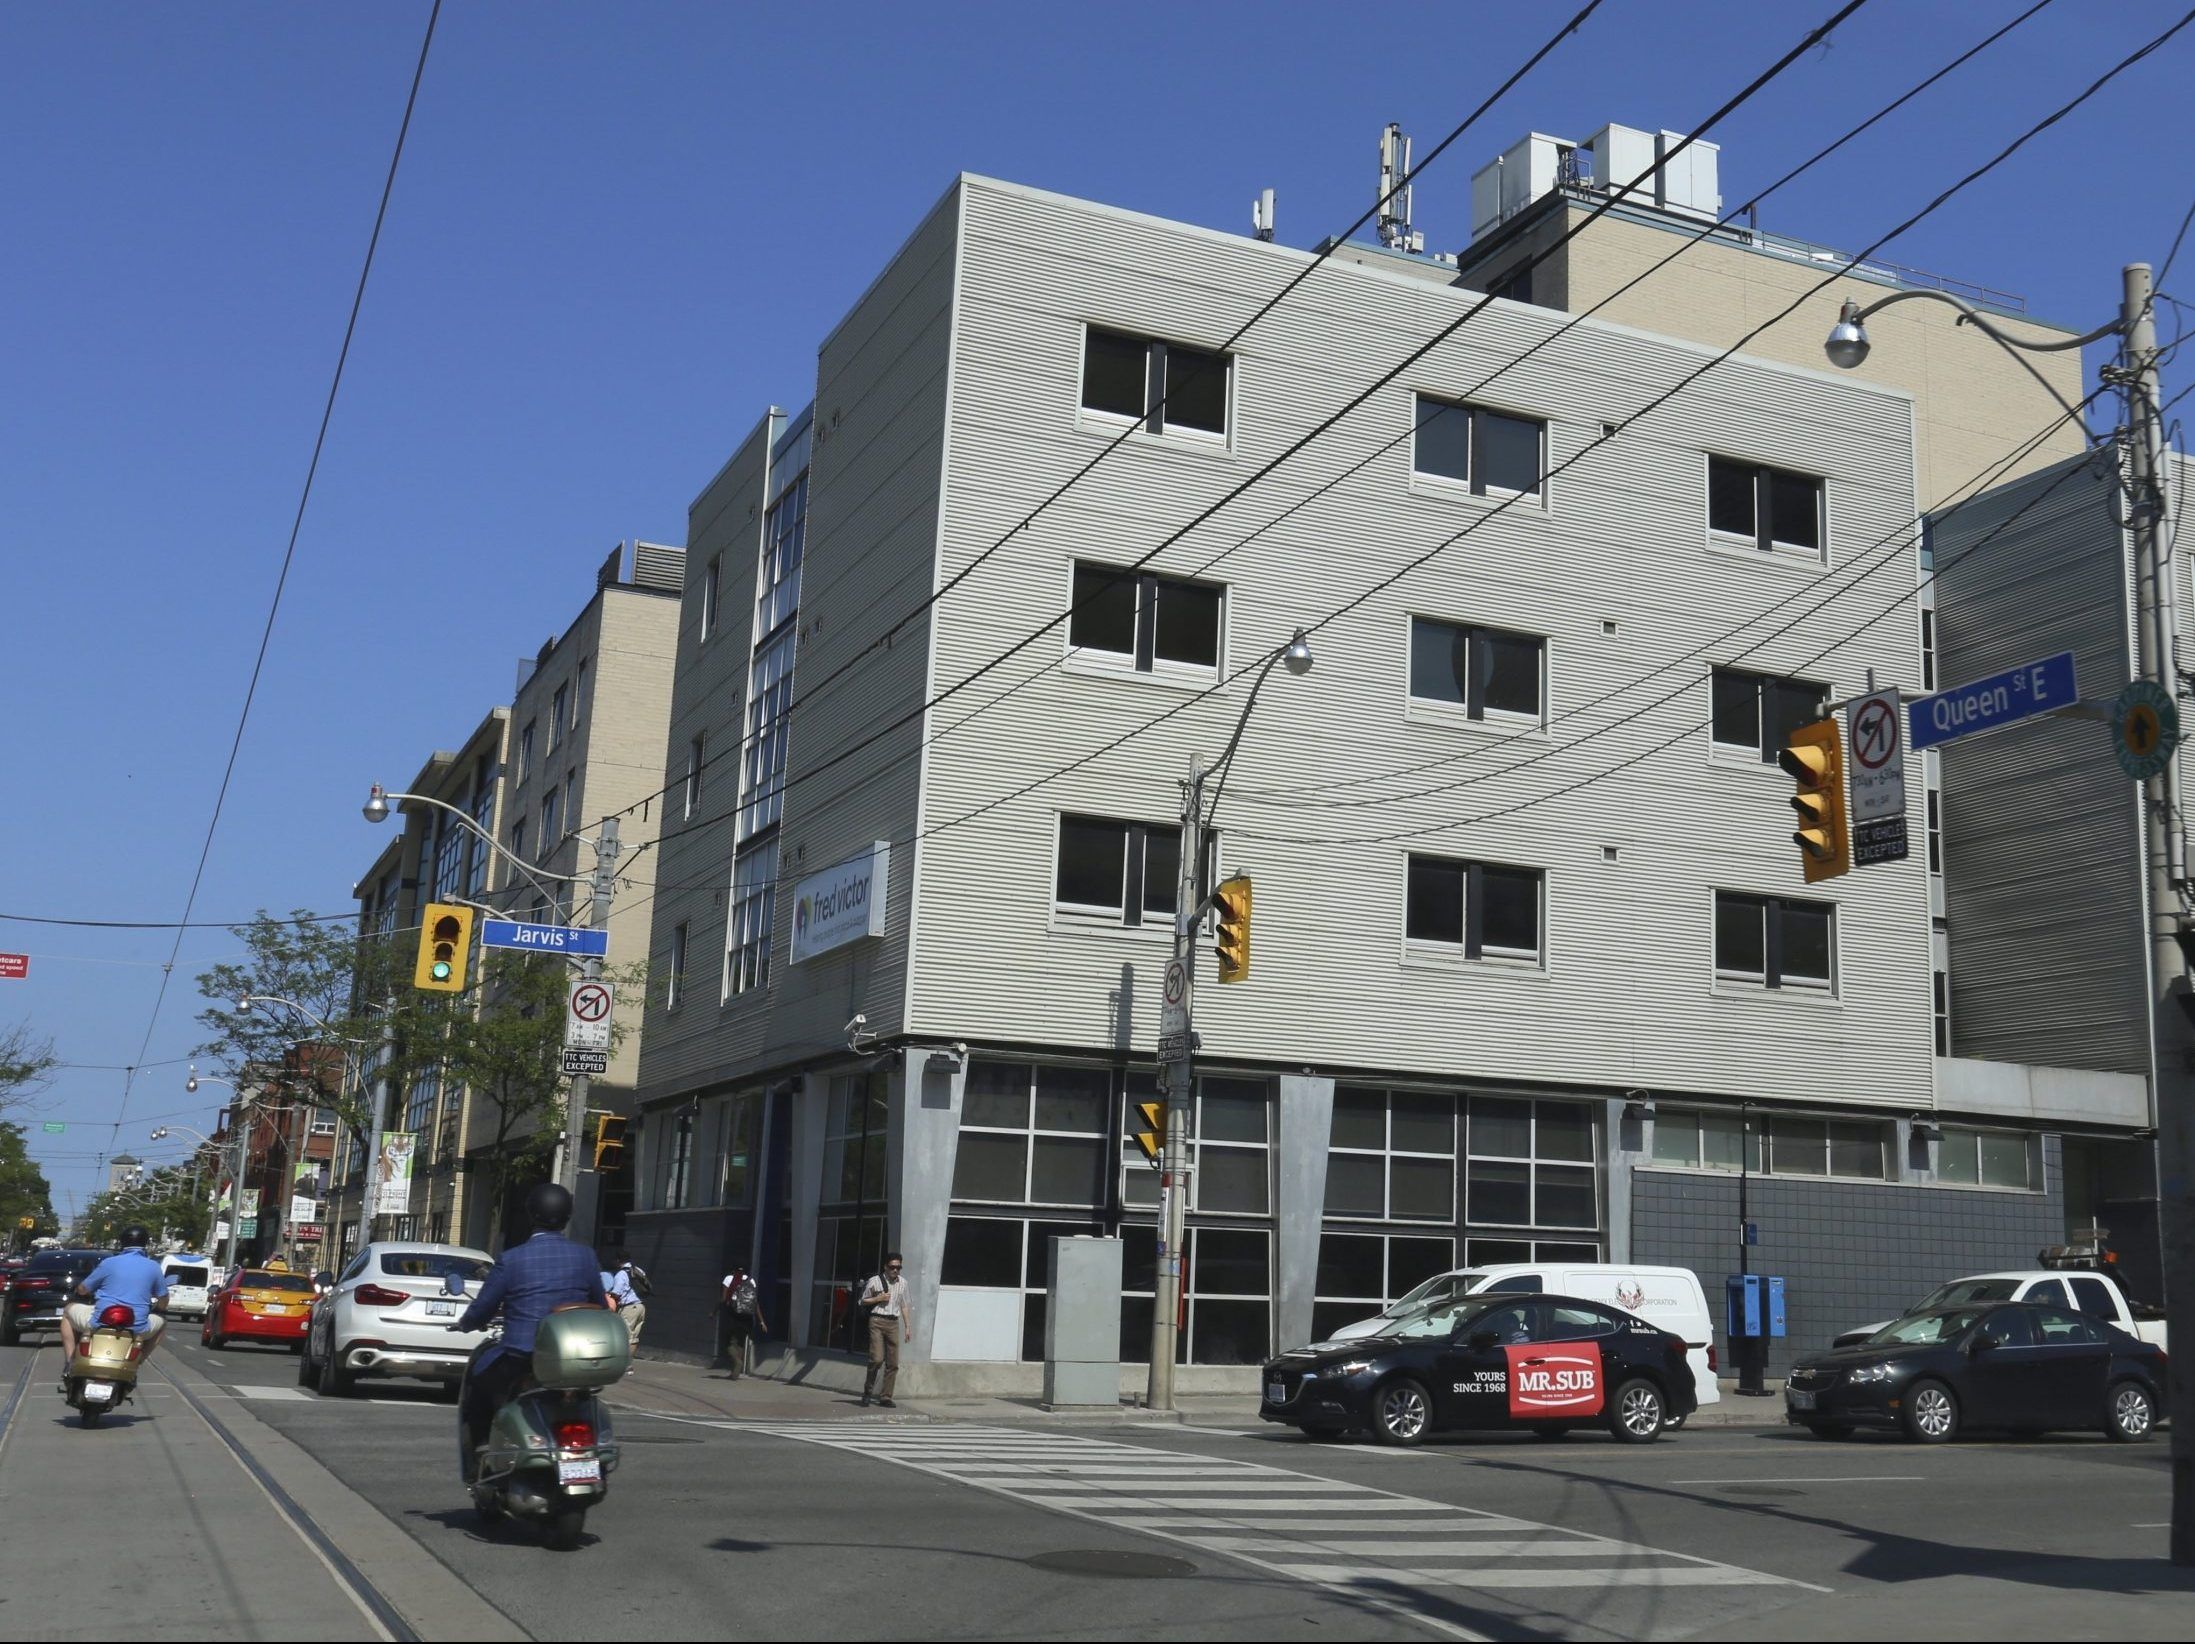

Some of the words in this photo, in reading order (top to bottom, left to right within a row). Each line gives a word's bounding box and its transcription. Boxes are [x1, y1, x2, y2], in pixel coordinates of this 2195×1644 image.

[1933, 686, 2008, 731] Queen
[2012, 673, 2027, 692] St
[2031, 666, 2047, 701] E
[1857, 841, 1905, 860] EXCEPTED
[814, 882, 837, 925] fred
[837, 875, 869, 913] victor
[512, 926, 564, 946] Jarvis
[569, 931, 579, 941] St
[565, 1053, 577, 1061] TTC
[579, 1054, 606, 1063] VEHICLES
[566, 1062, 604, 1071] EXCEPTED
[1474, 1371, 1506, 1382] YOURS
[1518, 1370, 1595, 1392] MR.SUB
[1453, 1383, 1482, 1393] SINCE
[1484, 1383, 1507, 1393] 1968
